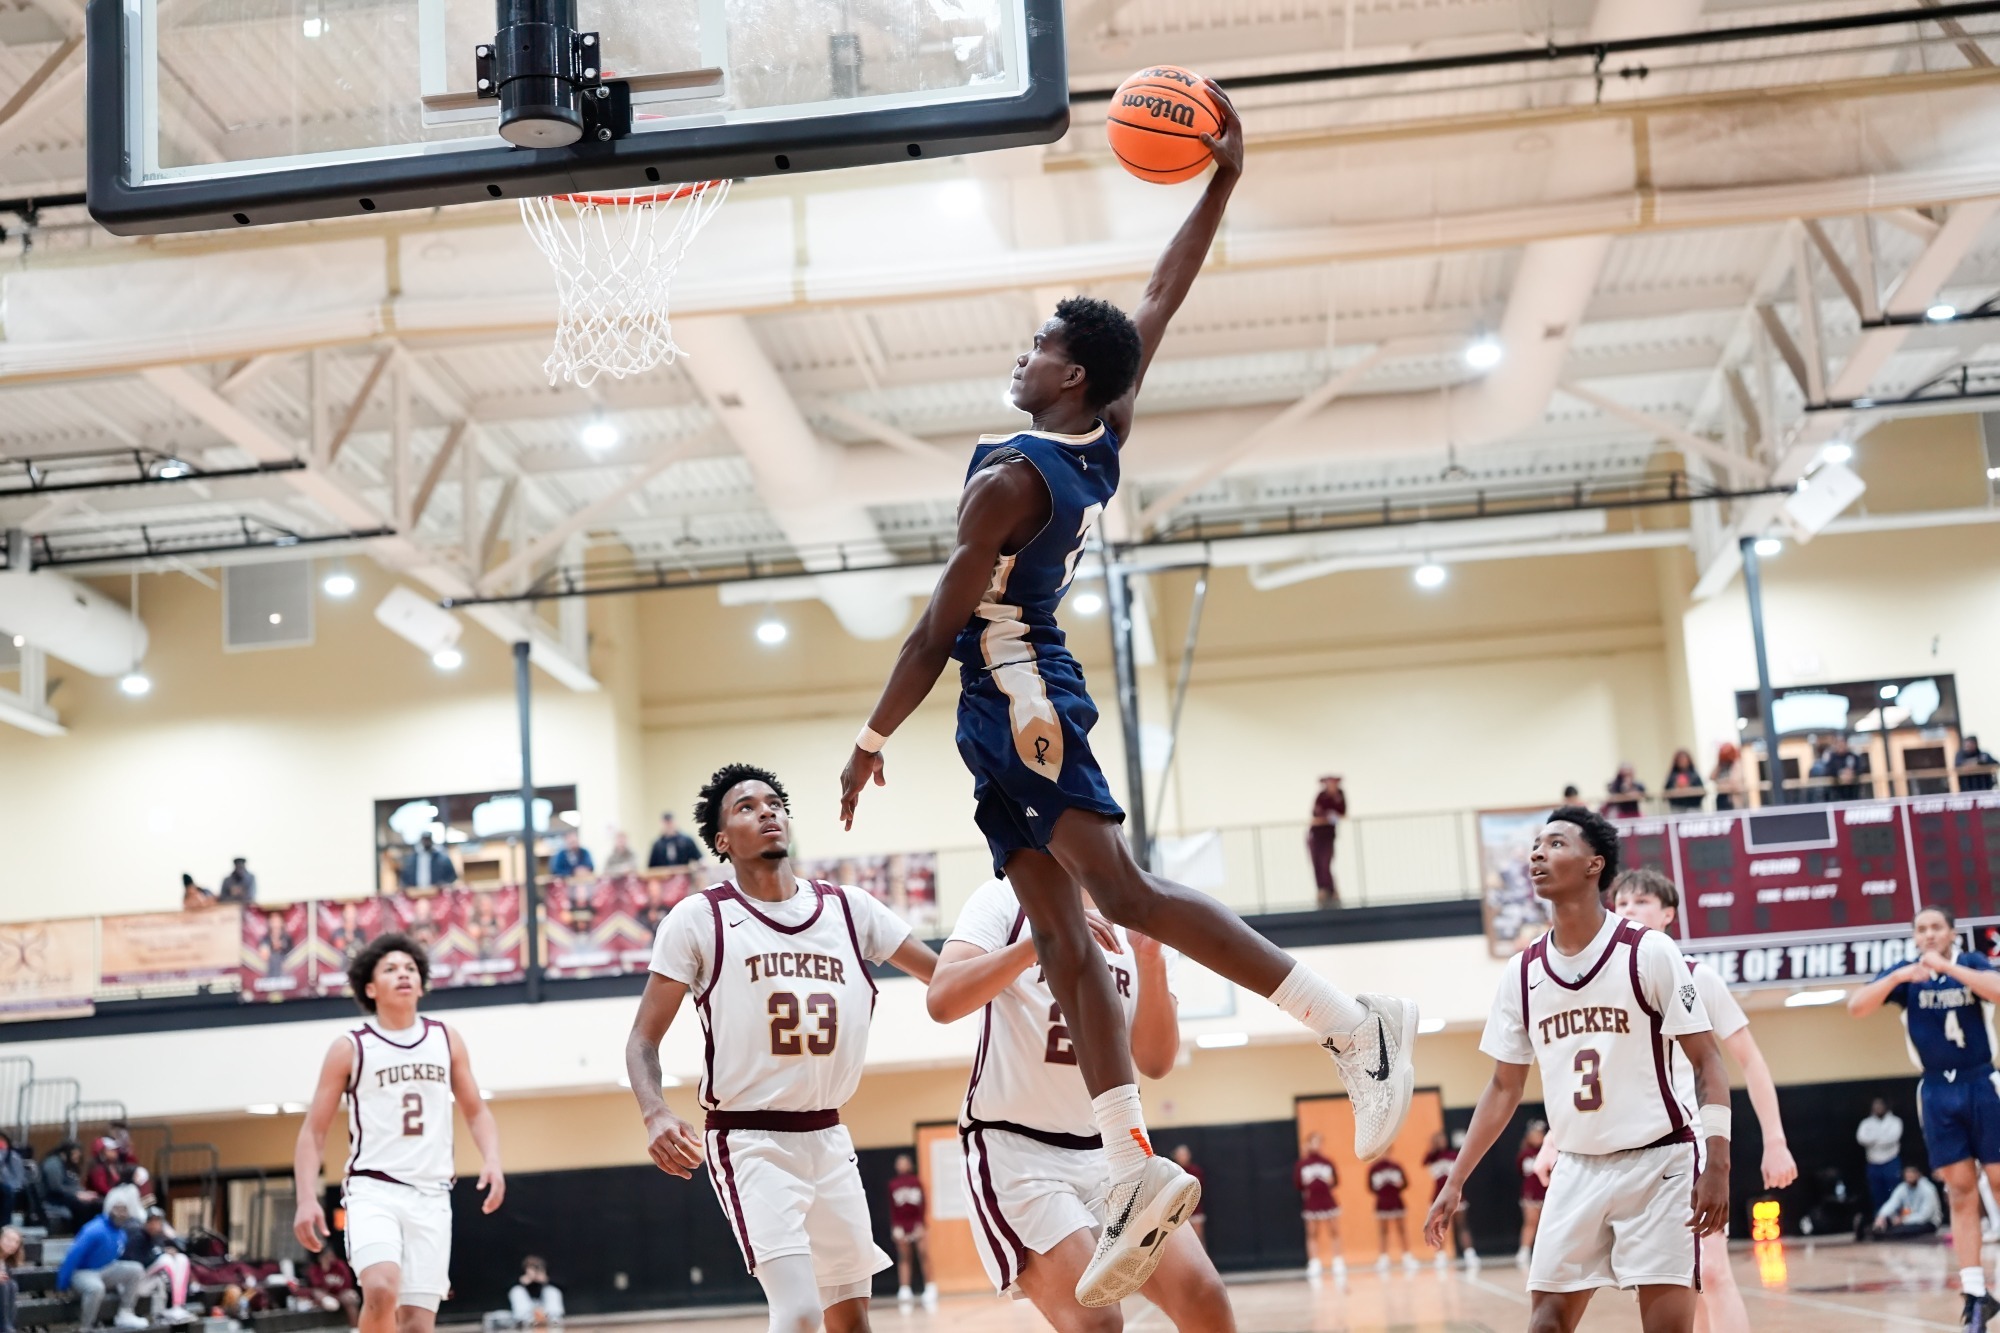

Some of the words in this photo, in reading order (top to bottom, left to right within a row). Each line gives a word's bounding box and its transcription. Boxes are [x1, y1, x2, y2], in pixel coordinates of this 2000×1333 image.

[1121, 94, 1195, 128] Wilson
[745, 952, 845, 985] TUCKER
[1743, 948, 1784, 982] OF
[1787, 943, 1847, 978] THE
[768, 991, 838, 1056] 23
[1538, 1006, 1631, 1045] TUCKER
[1944, 1010, 1967, 1049] 4
[375, 1063, 447, 1088] TUCKER
[1572, 1048, 1604, 1114] 3
[402, 1092, 424, 1136] 2
